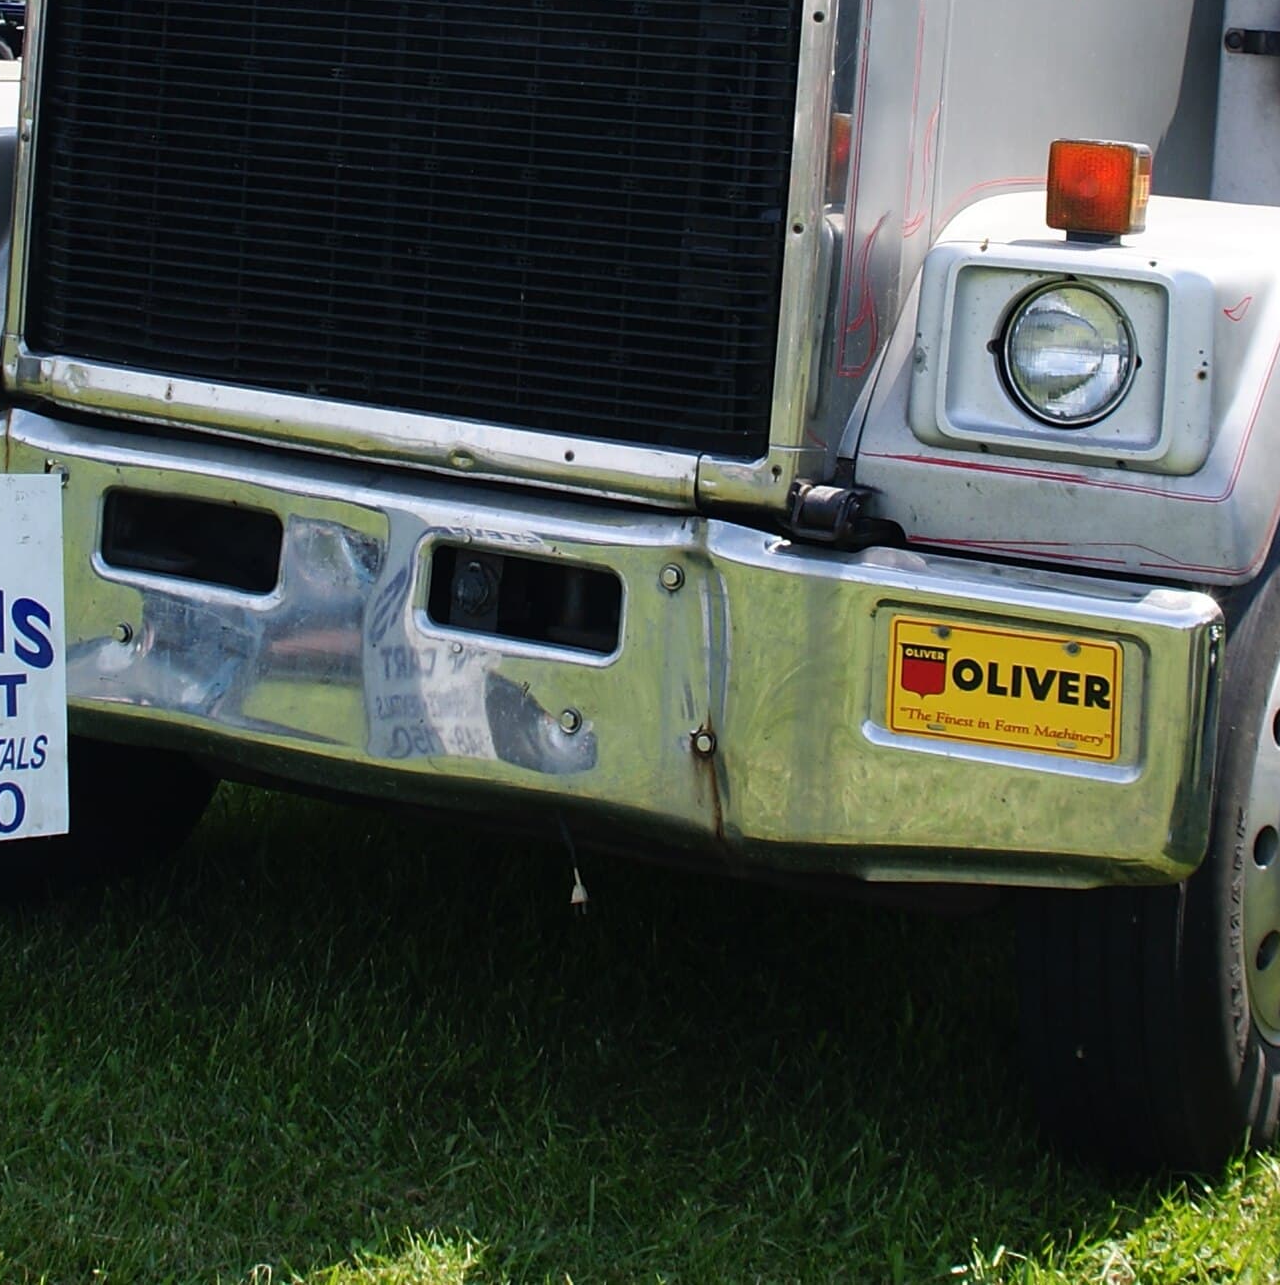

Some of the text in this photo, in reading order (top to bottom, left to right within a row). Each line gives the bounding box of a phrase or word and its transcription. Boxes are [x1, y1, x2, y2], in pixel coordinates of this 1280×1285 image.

[904, 647, 946, 661] OLIVER
[952, 658, 1112, 710] OLIVER
[935, 711, 974, 728] Finest
[977, 717, 991, 730] in
[994, 718, 1030, 735] Farm
